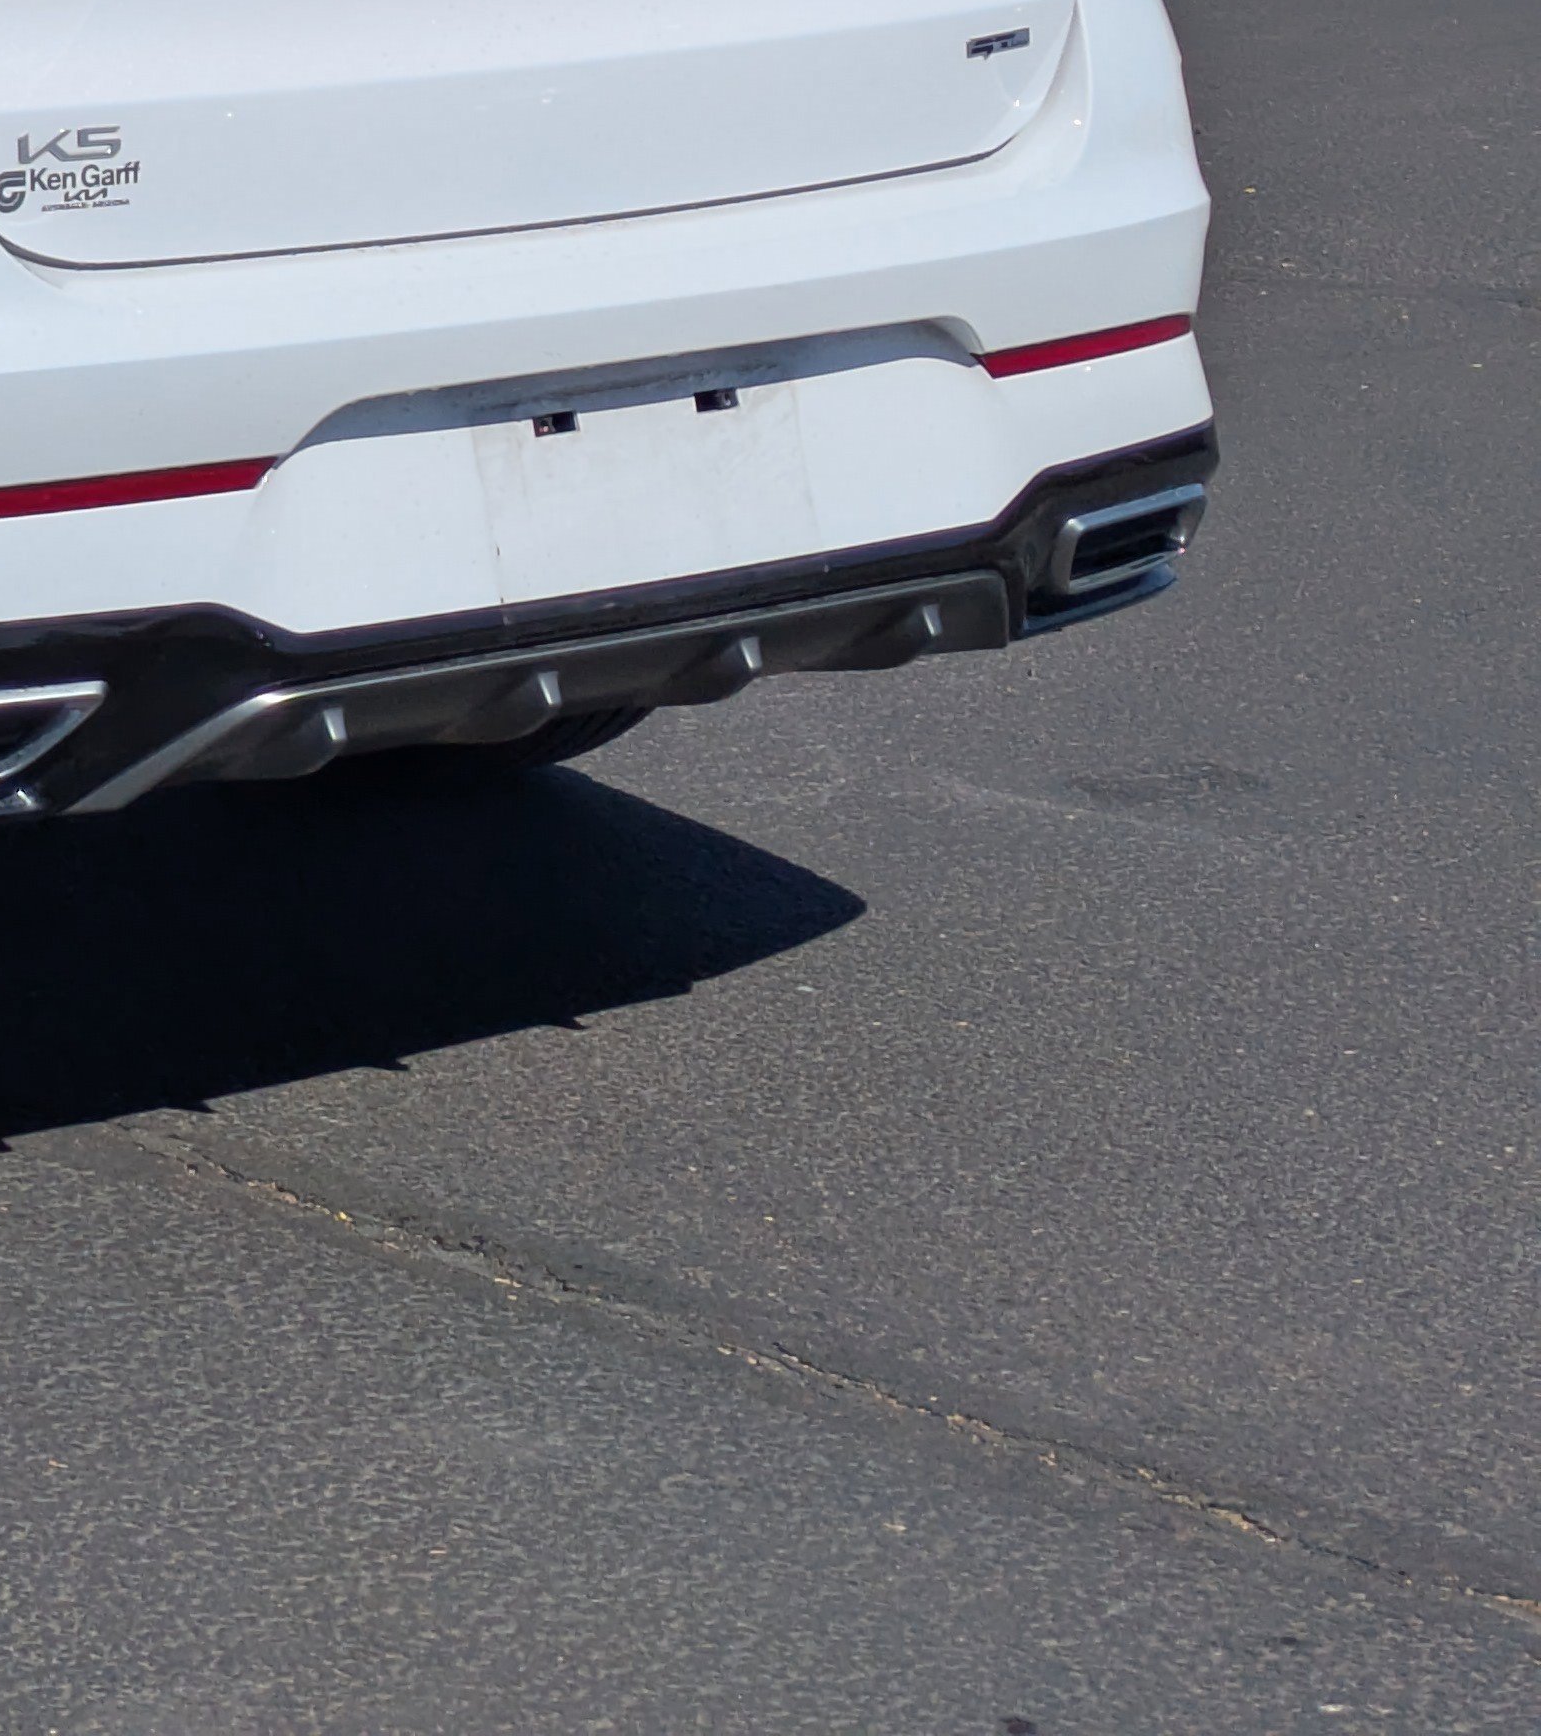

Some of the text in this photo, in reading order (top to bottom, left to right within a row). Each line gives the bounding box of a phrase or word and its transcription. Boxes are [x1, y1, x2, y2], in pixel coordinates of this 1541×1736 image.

[17, 125, 122, 165] K5
[29, 161, 141, 193] Ken Garff
